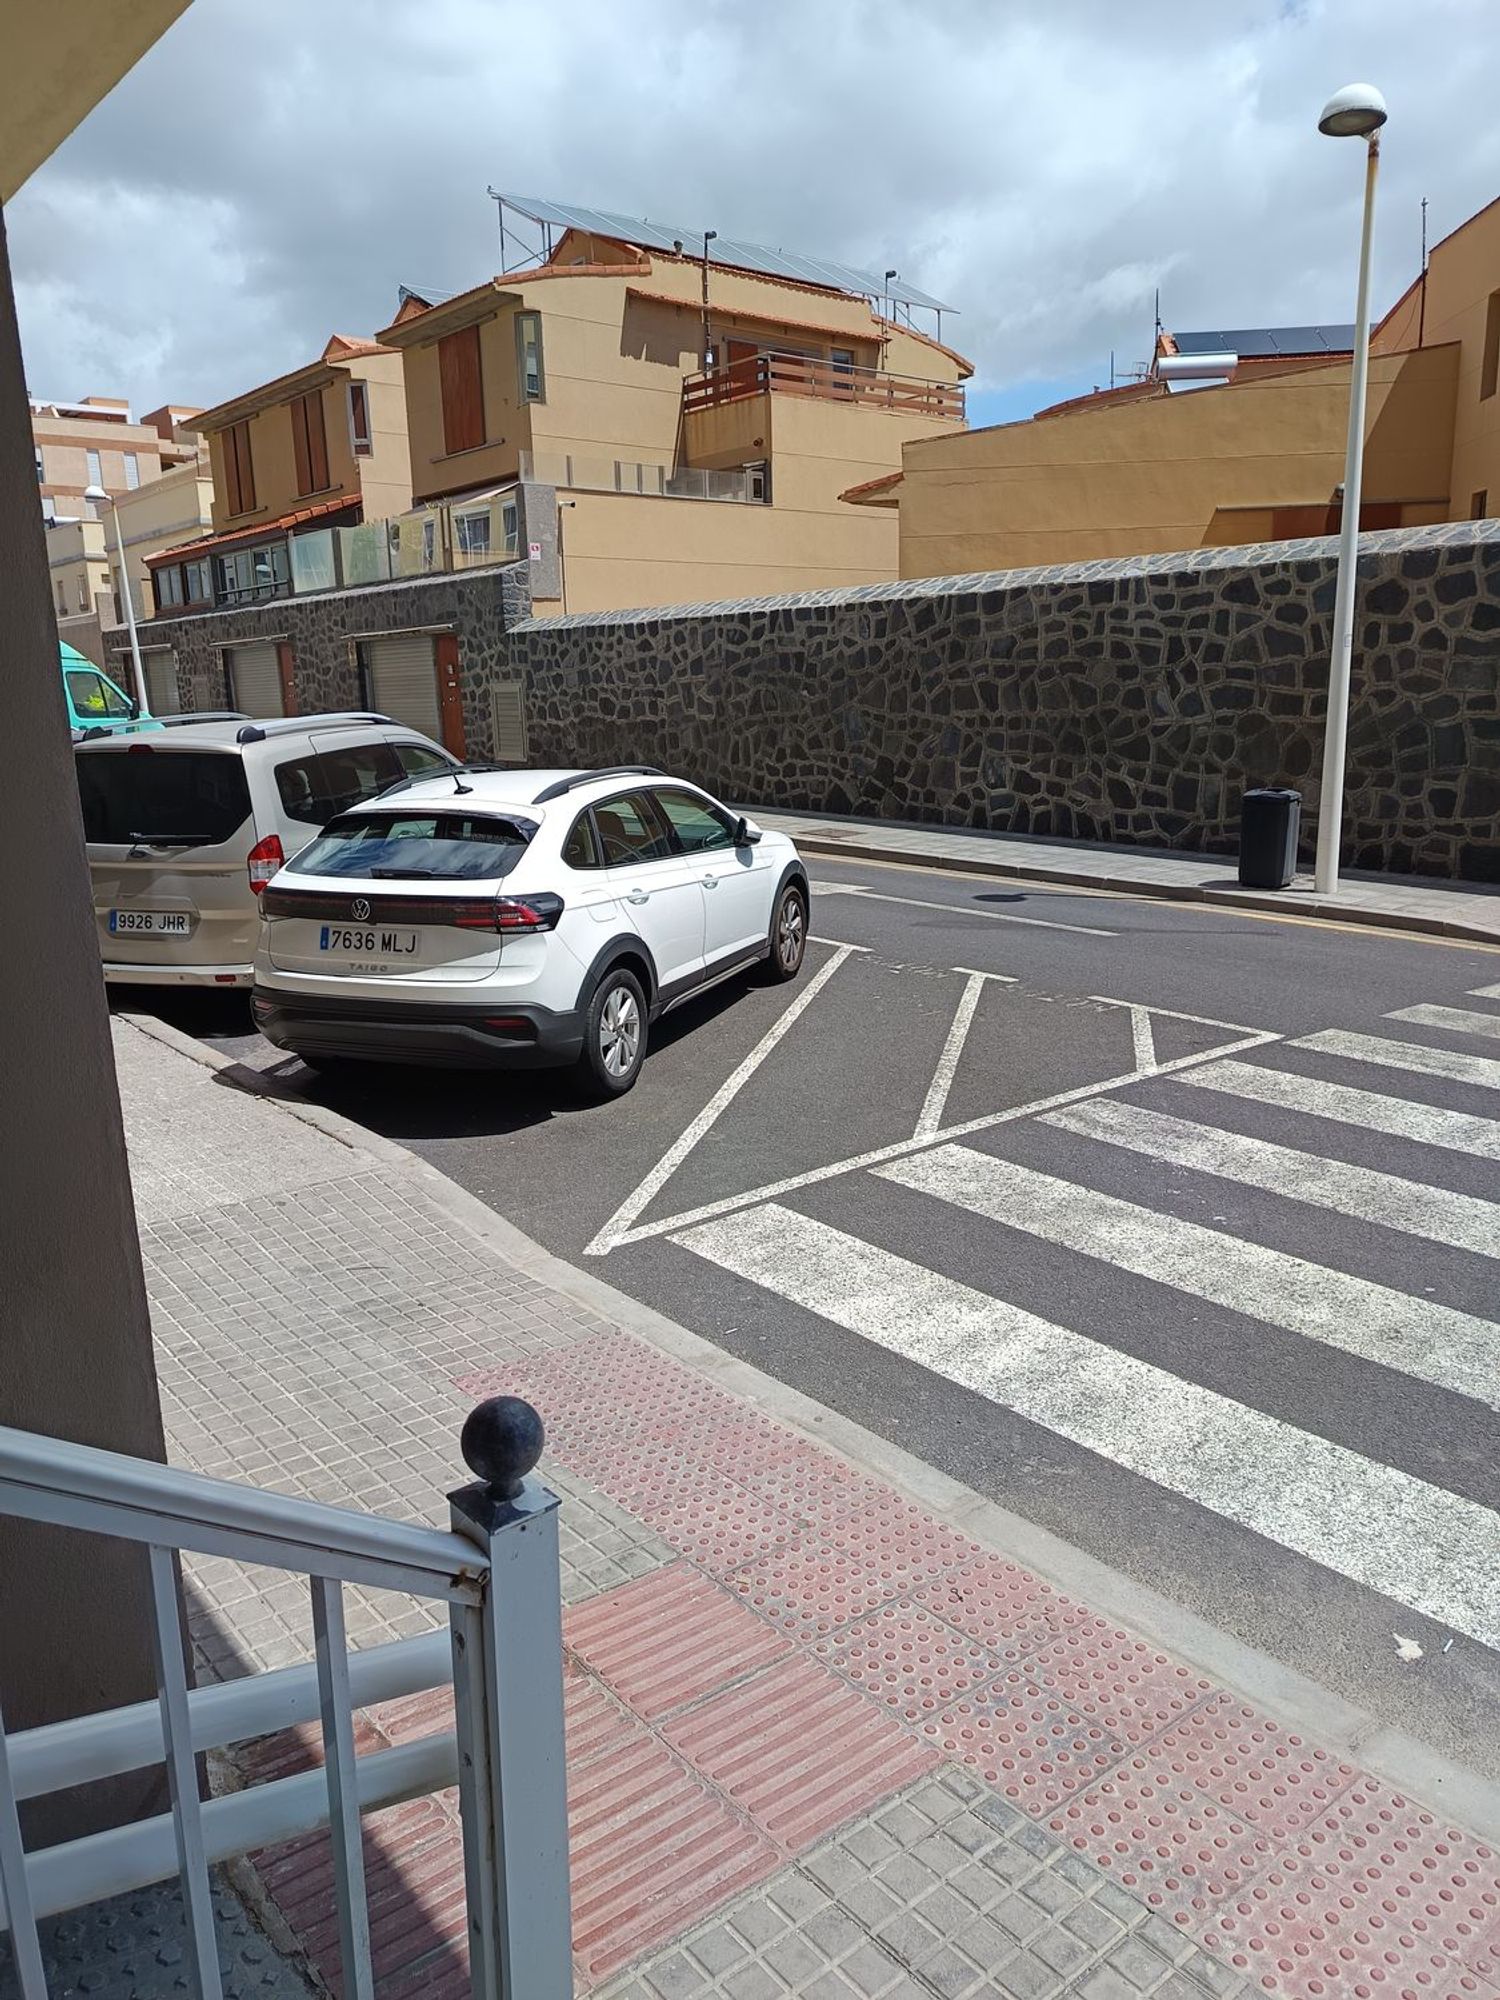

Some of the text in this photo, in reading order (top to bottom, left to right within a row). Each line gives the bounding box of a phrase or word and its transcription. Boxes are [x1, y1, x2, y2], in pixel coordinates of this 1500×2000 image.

[118, 913, 186, 931] 9926 JHR
[331, 930, 416, 953] 7636 MLJ
